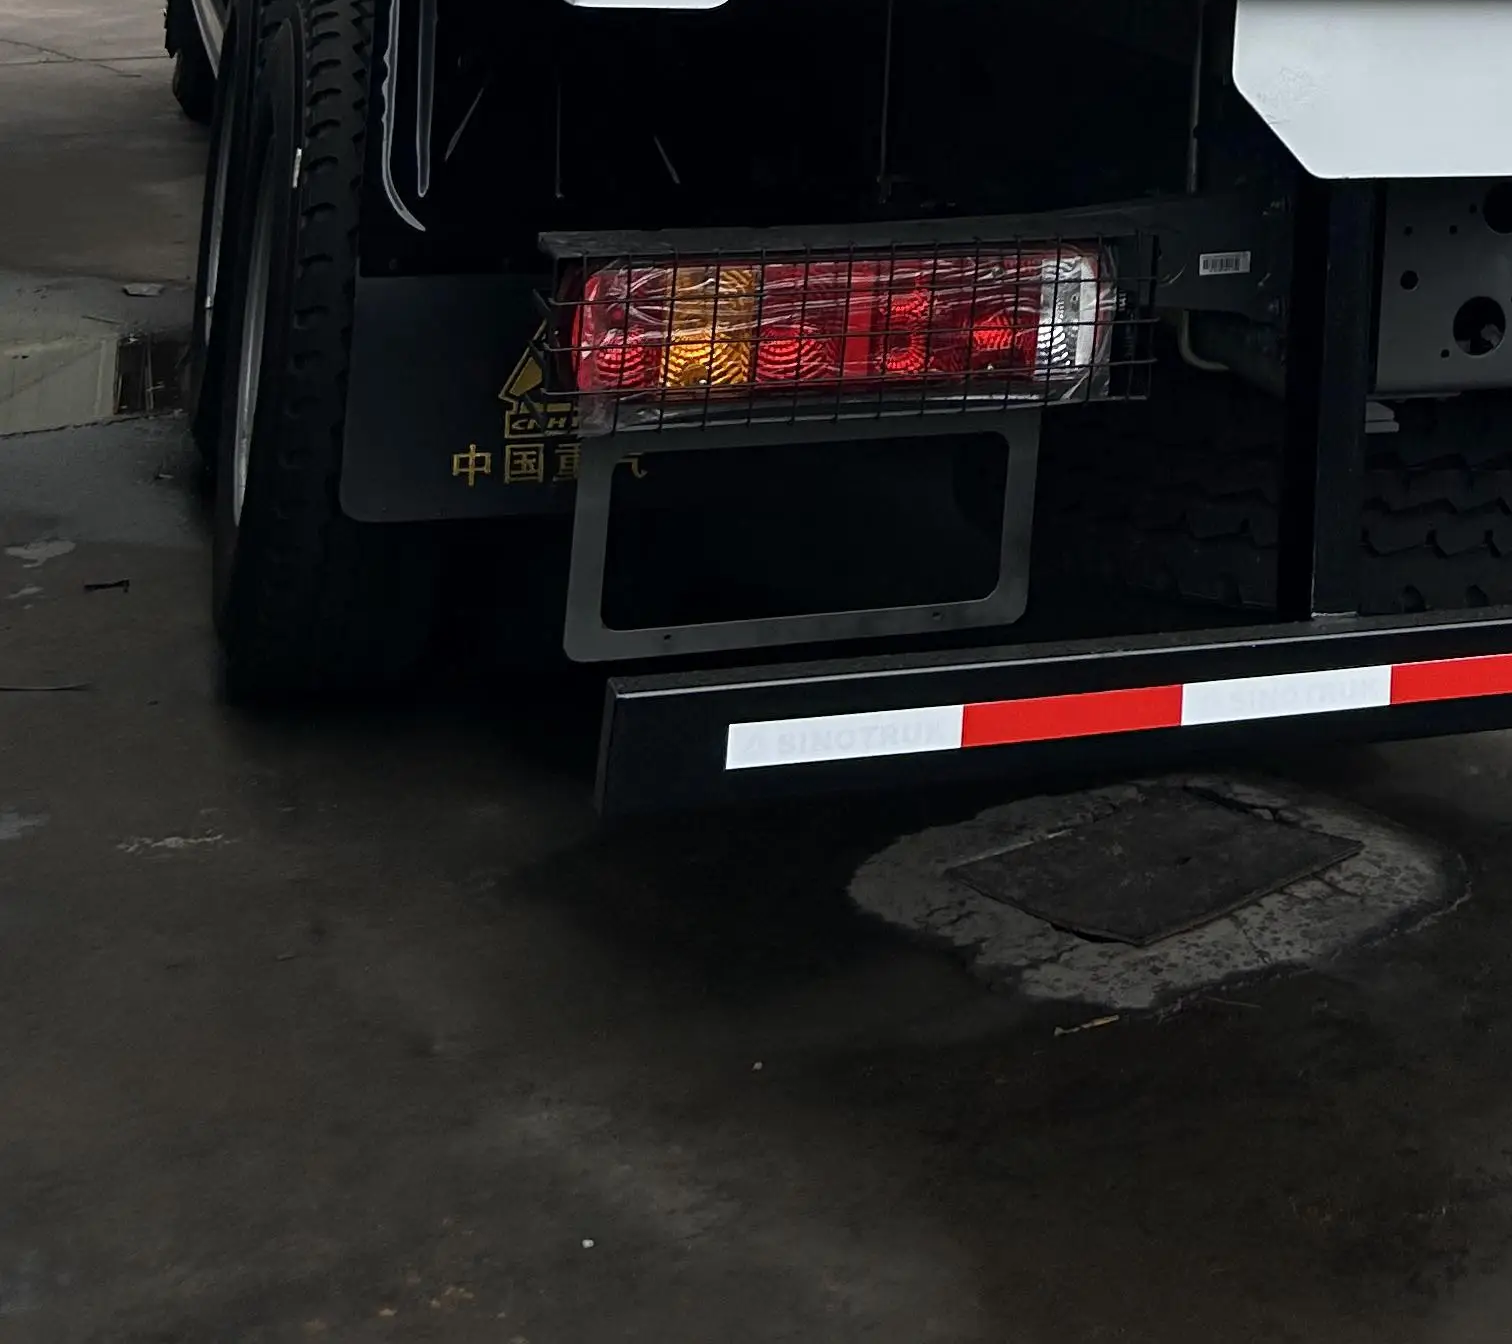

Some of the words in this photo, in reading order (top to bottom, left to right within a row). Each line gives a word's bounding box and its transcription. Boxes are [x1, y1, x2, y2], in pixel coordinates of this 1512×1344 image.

[451, 441, 649, 487] 中国重
[777, 721, 944, 756] SINOTRUK
